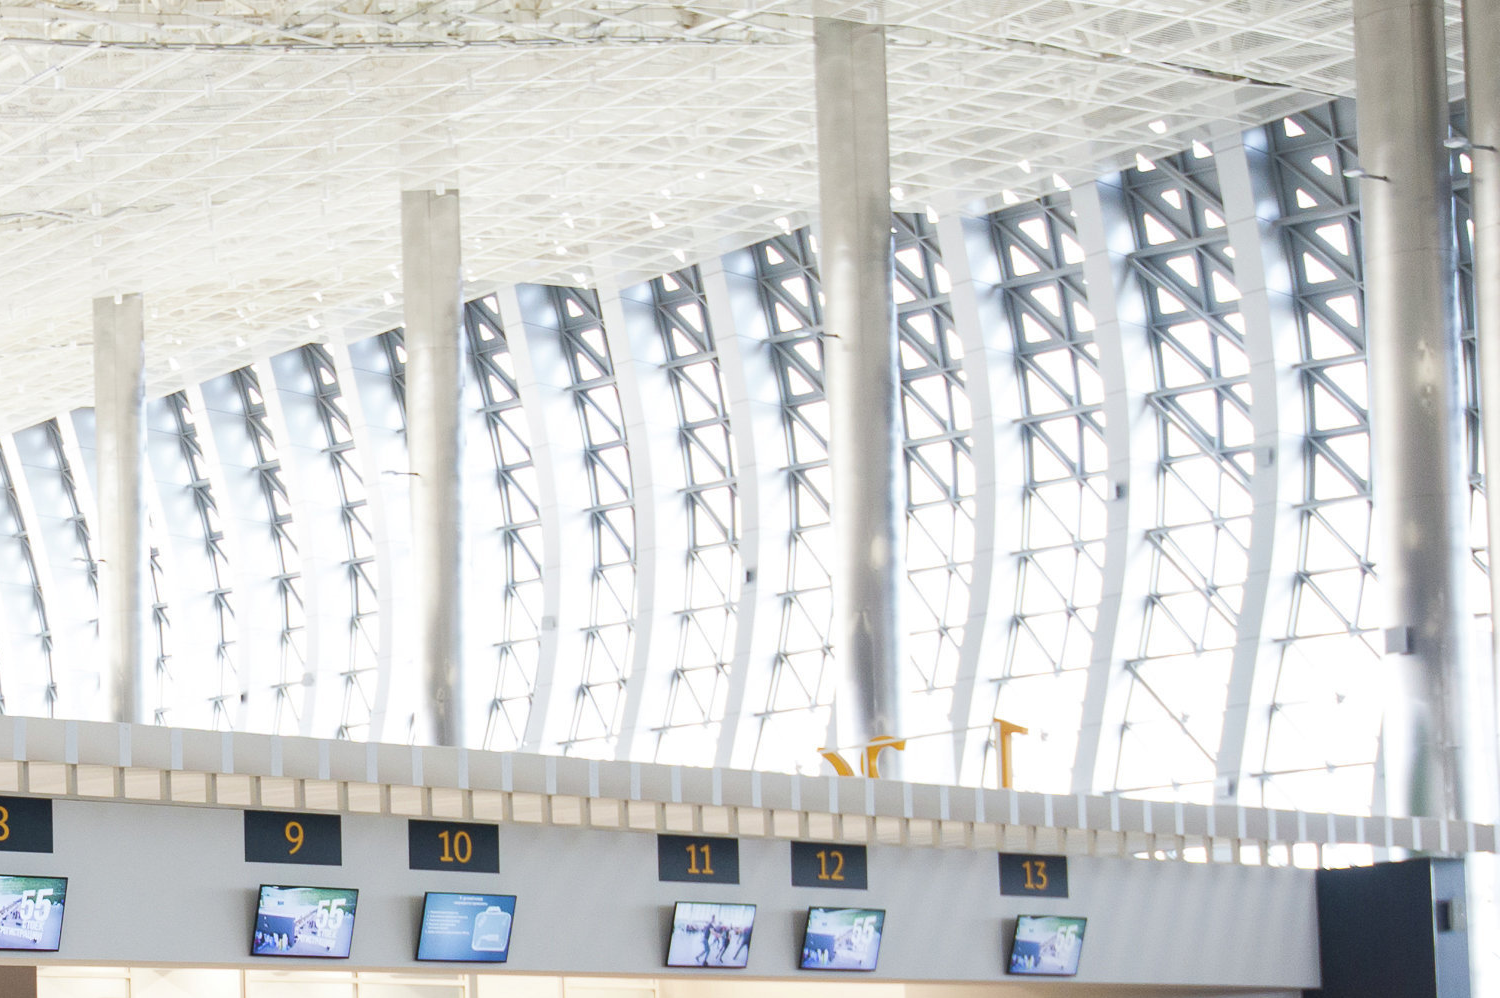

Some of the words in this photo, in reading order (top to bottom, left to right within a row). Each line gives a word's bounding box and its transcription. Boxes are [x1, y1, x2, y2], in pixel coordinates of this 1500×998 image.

[285, 821, 304, 855] 9
[438, 830, 473, 863] 10
[686, 843, 714, 875] 11
[816, 850, 845, 881] 12
[1022, 860, 1048, 890] 13
[19, 889, 54, 921] 55
[315, 899, 346, 929] 55
[852, 915, 878, 944] 55
